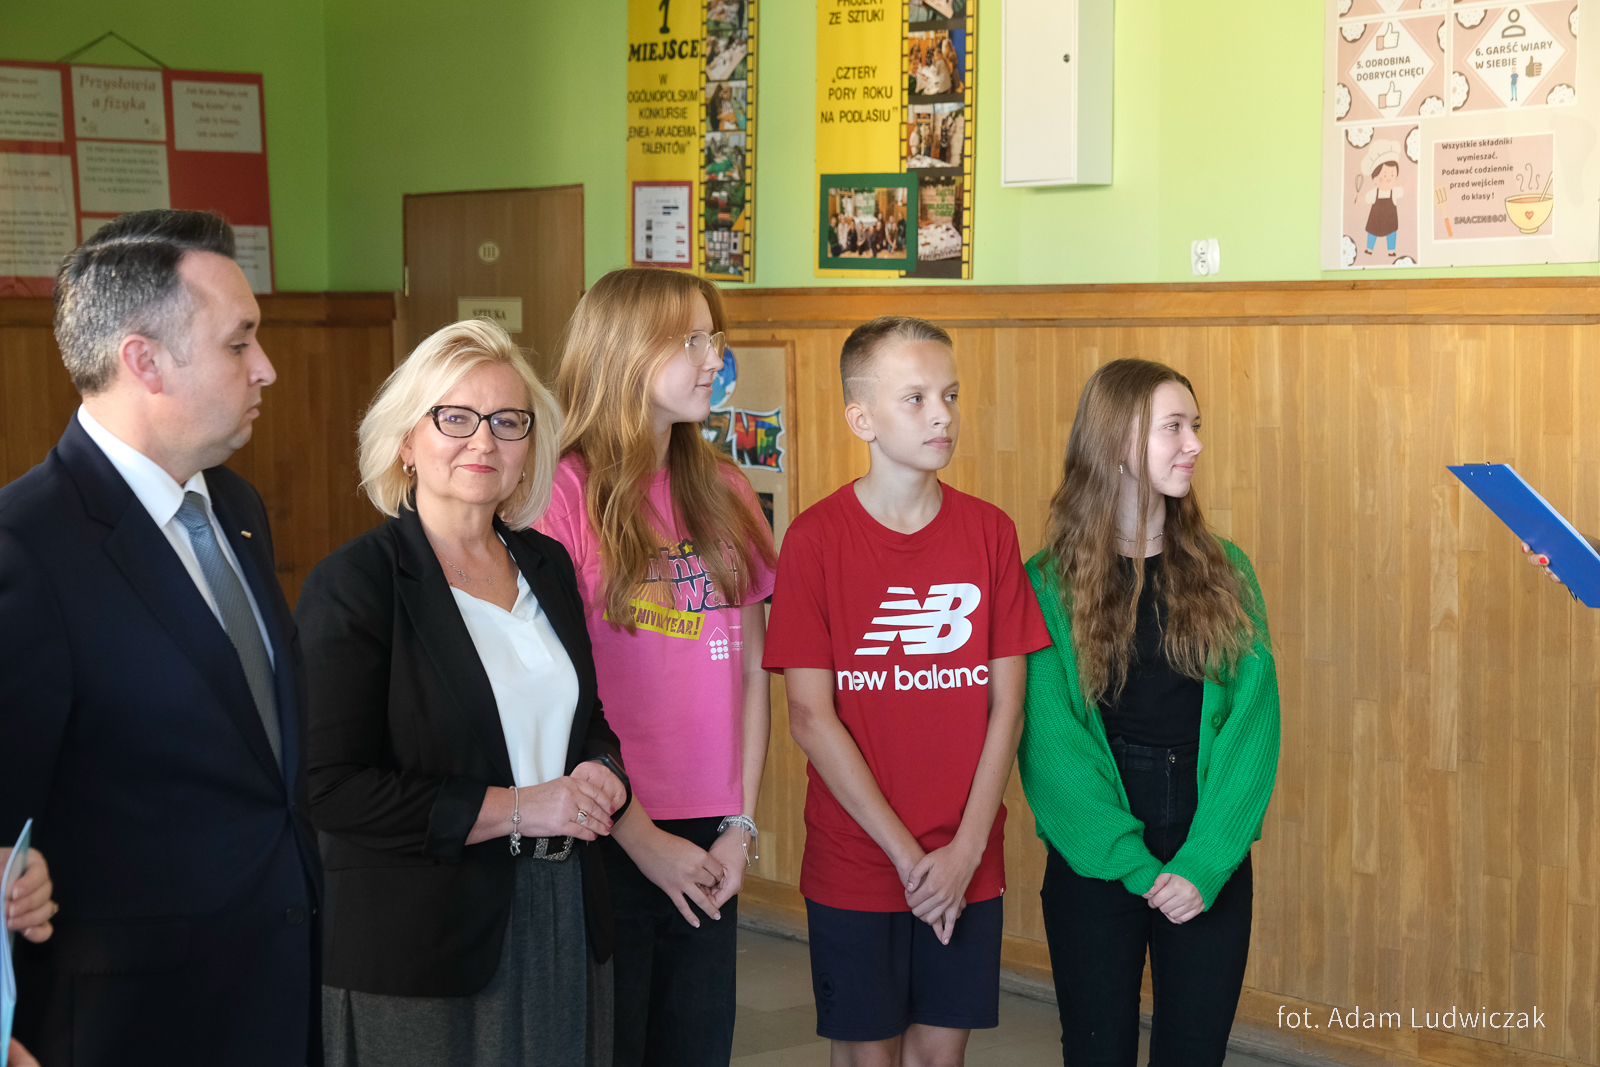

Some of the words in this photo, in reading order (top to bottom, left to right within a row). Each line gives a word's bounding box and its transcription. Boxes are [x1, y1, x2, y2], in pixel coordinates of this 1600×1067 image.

[659, 0, 670, 34] 1
[828, 11, 842, 25] ZE
[847, 9, 885, 24] SZTUKI
[627, 39, 699, 62] MIEJSCE
[1475, 47, 1484, 57] 6.
[1486, 42, 1518, 56] GARŚĆ
[1520, 41, 1553, 52] WIARY
[1357, 61, 1364, 70] 5.
[1365, 56, 1411, 68] ODROBINA
[1475, 60, 1485, 70] W
[1486, 57, 1518, 68] SIEBIE
[659, 74, 668, 85] W
[1356, 69, 1397, 82] DOBRYCH
[1398, 67, 1424, 80] CHĘCI
[626, 89, 698, 103] OGÓLNOPOLSKIM
[828, 87, 857, 100] PORY
[863, 85, 893, 99] ROKU
[91, 98, 100, 108] a
[102, 95, 147, 114] fizyka
[638, 107, 687, 120] KONKURSIE
[820, 111, 834, 123] NA
[1441, 141, 1477, 150] Wszystkie
[1478, 137, 1513, 148] składniki
[1456, 151, 1498, 163] wymieszać.
[1441, 166, 1474, 176] Podawać
[1474, 163, 1514, 174] codziennie
[1449, 180, 1470, 190] przed
[1471, 178, 1505, 188] wejściem
[1461, 193, 1471, 201] do
[666, 616, 702, 636] YEAR!
[837, 670, 888, 692] new
